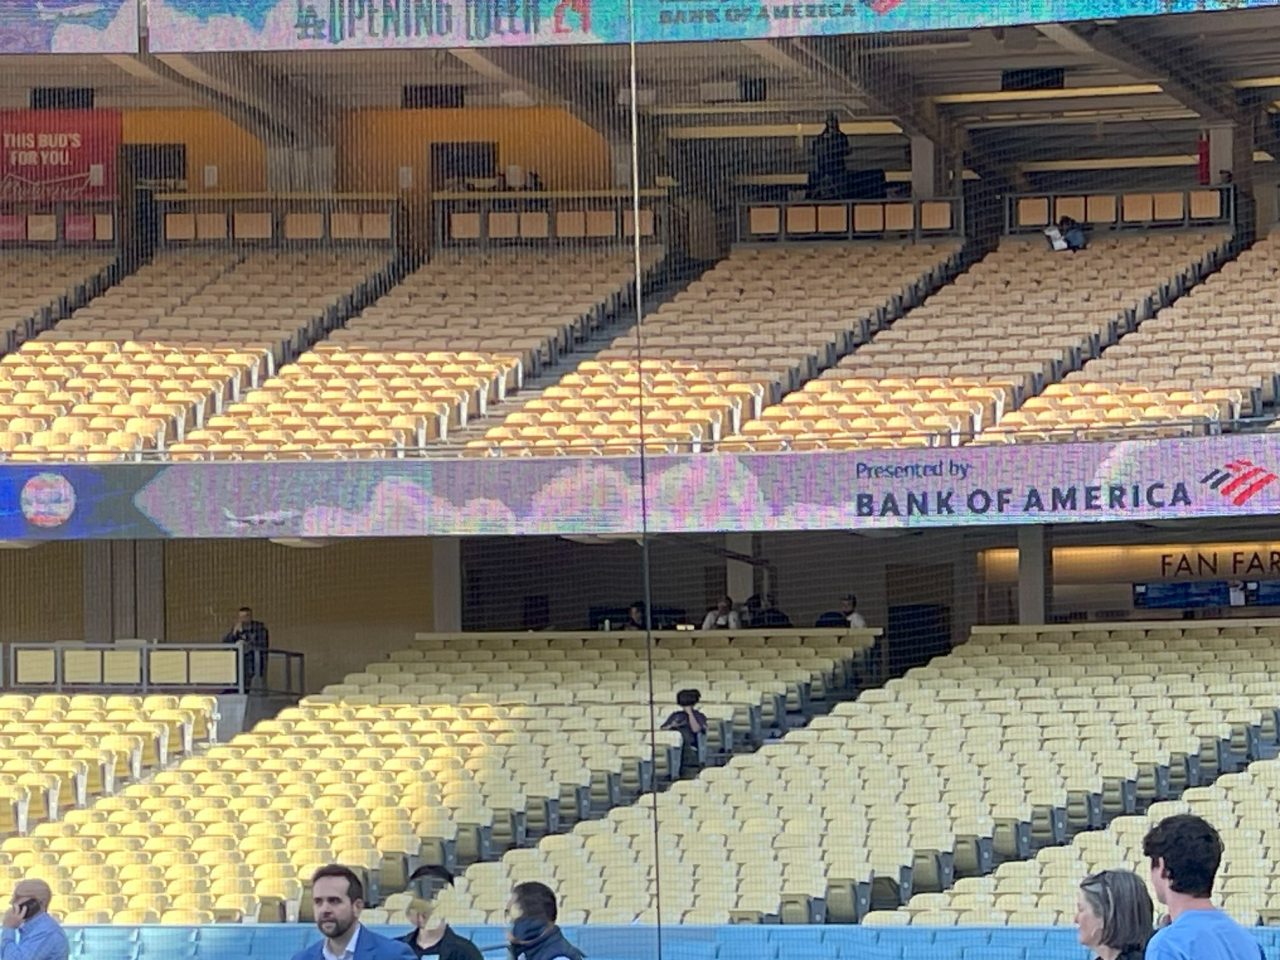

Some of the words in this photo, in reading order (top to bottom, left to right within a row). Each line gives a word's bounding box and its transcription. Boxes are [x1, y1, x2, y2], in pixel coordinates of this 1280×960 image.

[659, 8, 721, 24] BANK
[756, 3, 857, 21] AMERICA
[3, 133, 35, 148] THIS
[37, 133, 82, 148] BUD'S
[11, 150, 38, 166] FOR
[856, 460, 943, 480] Presented
[948, 461, 971, 482] by
[856, 491, 956, 517] BANK
[966, 488, 1013, 515] OF
[1023, 482, 1193, 512] AMERICA
[1161, 552, 1218, 577] FAN
